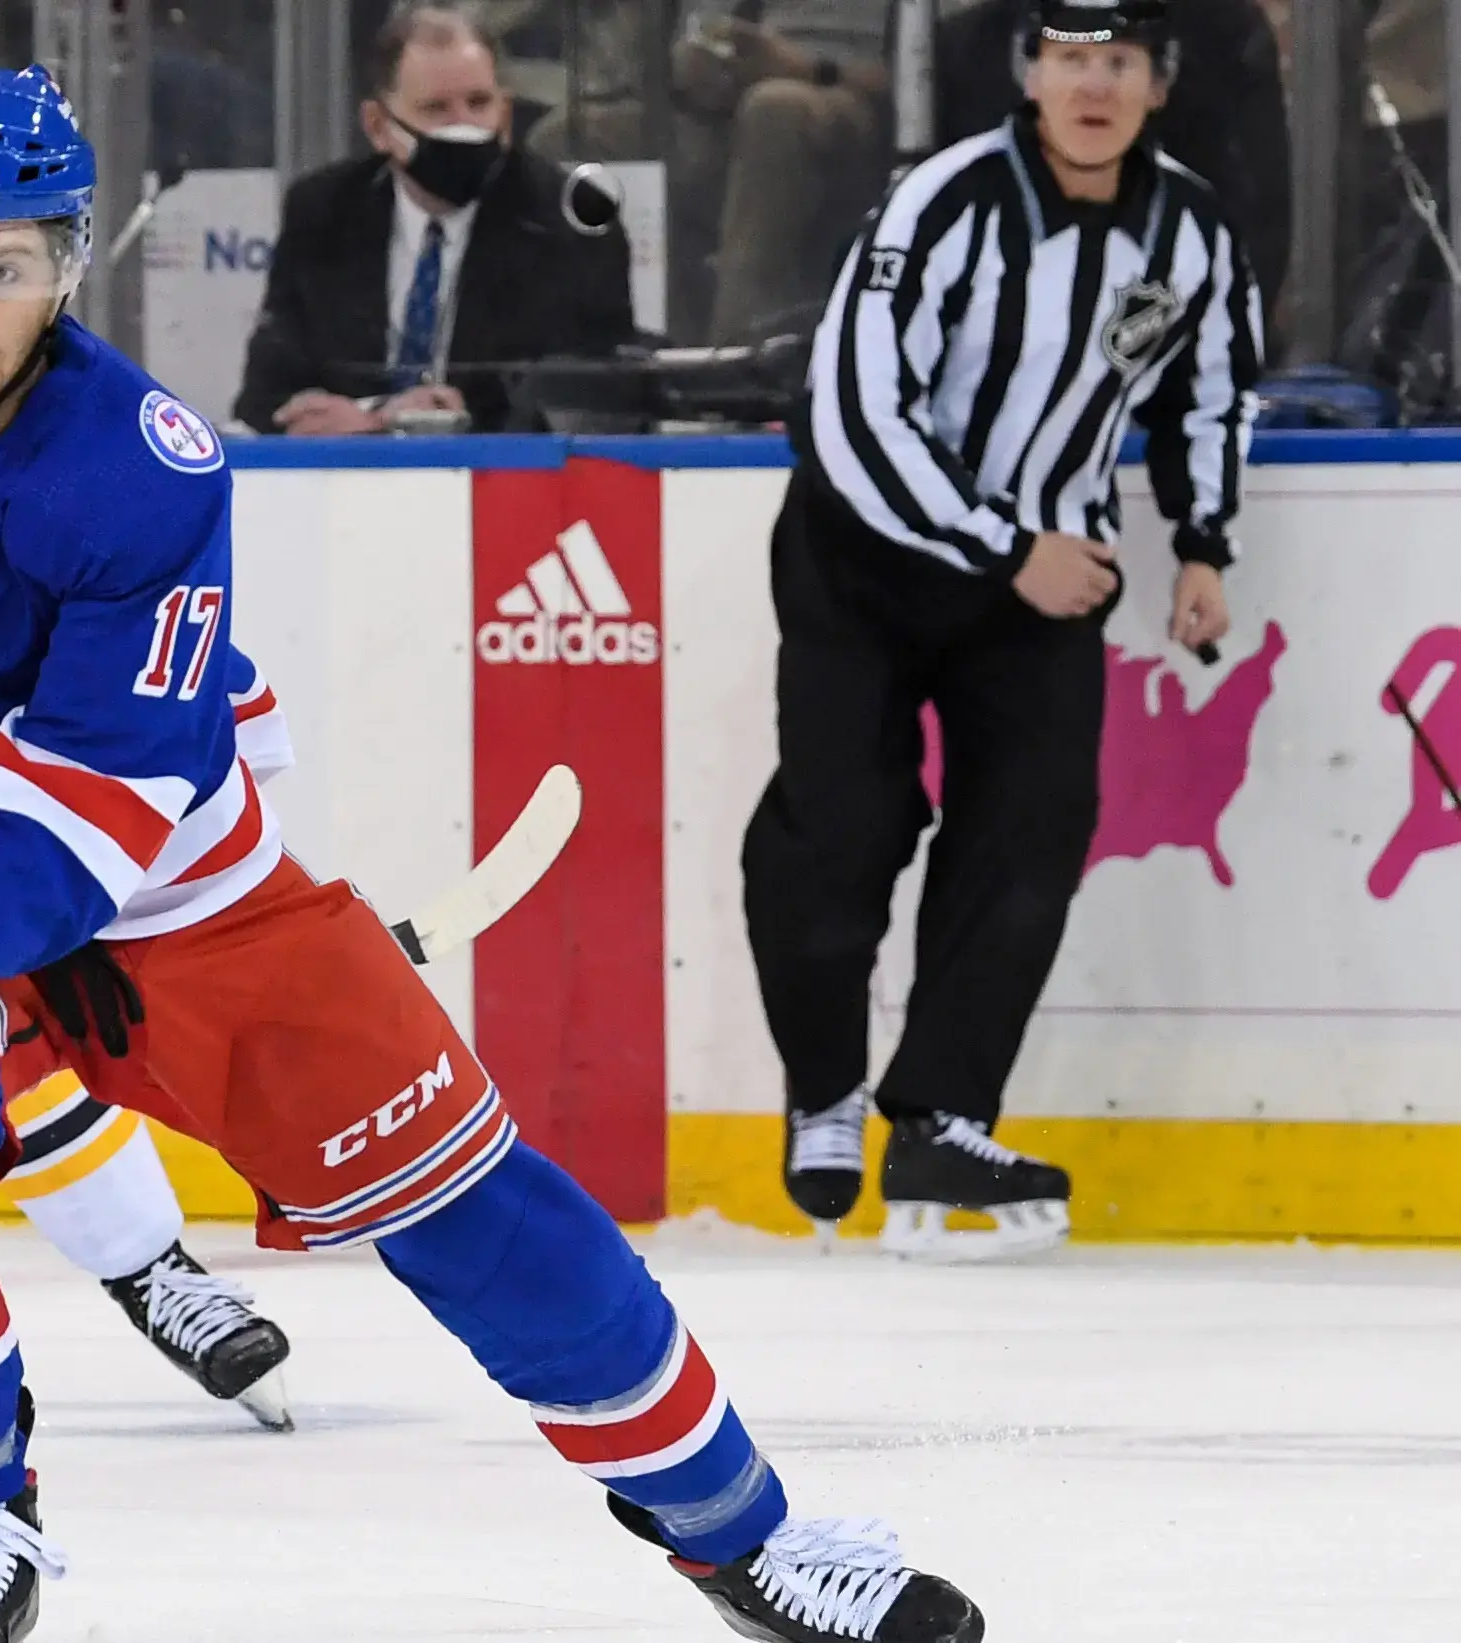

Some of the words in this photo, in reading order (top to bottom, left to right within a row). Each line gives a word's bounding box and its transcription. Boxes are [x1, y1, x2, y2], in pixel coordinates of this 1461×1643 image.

[868, 251, 907, 289] 13
[133, 586, 224, 701] 17
[477, 610, 659, 665] adidas
[318, 1050, 455, 1168] CCM
